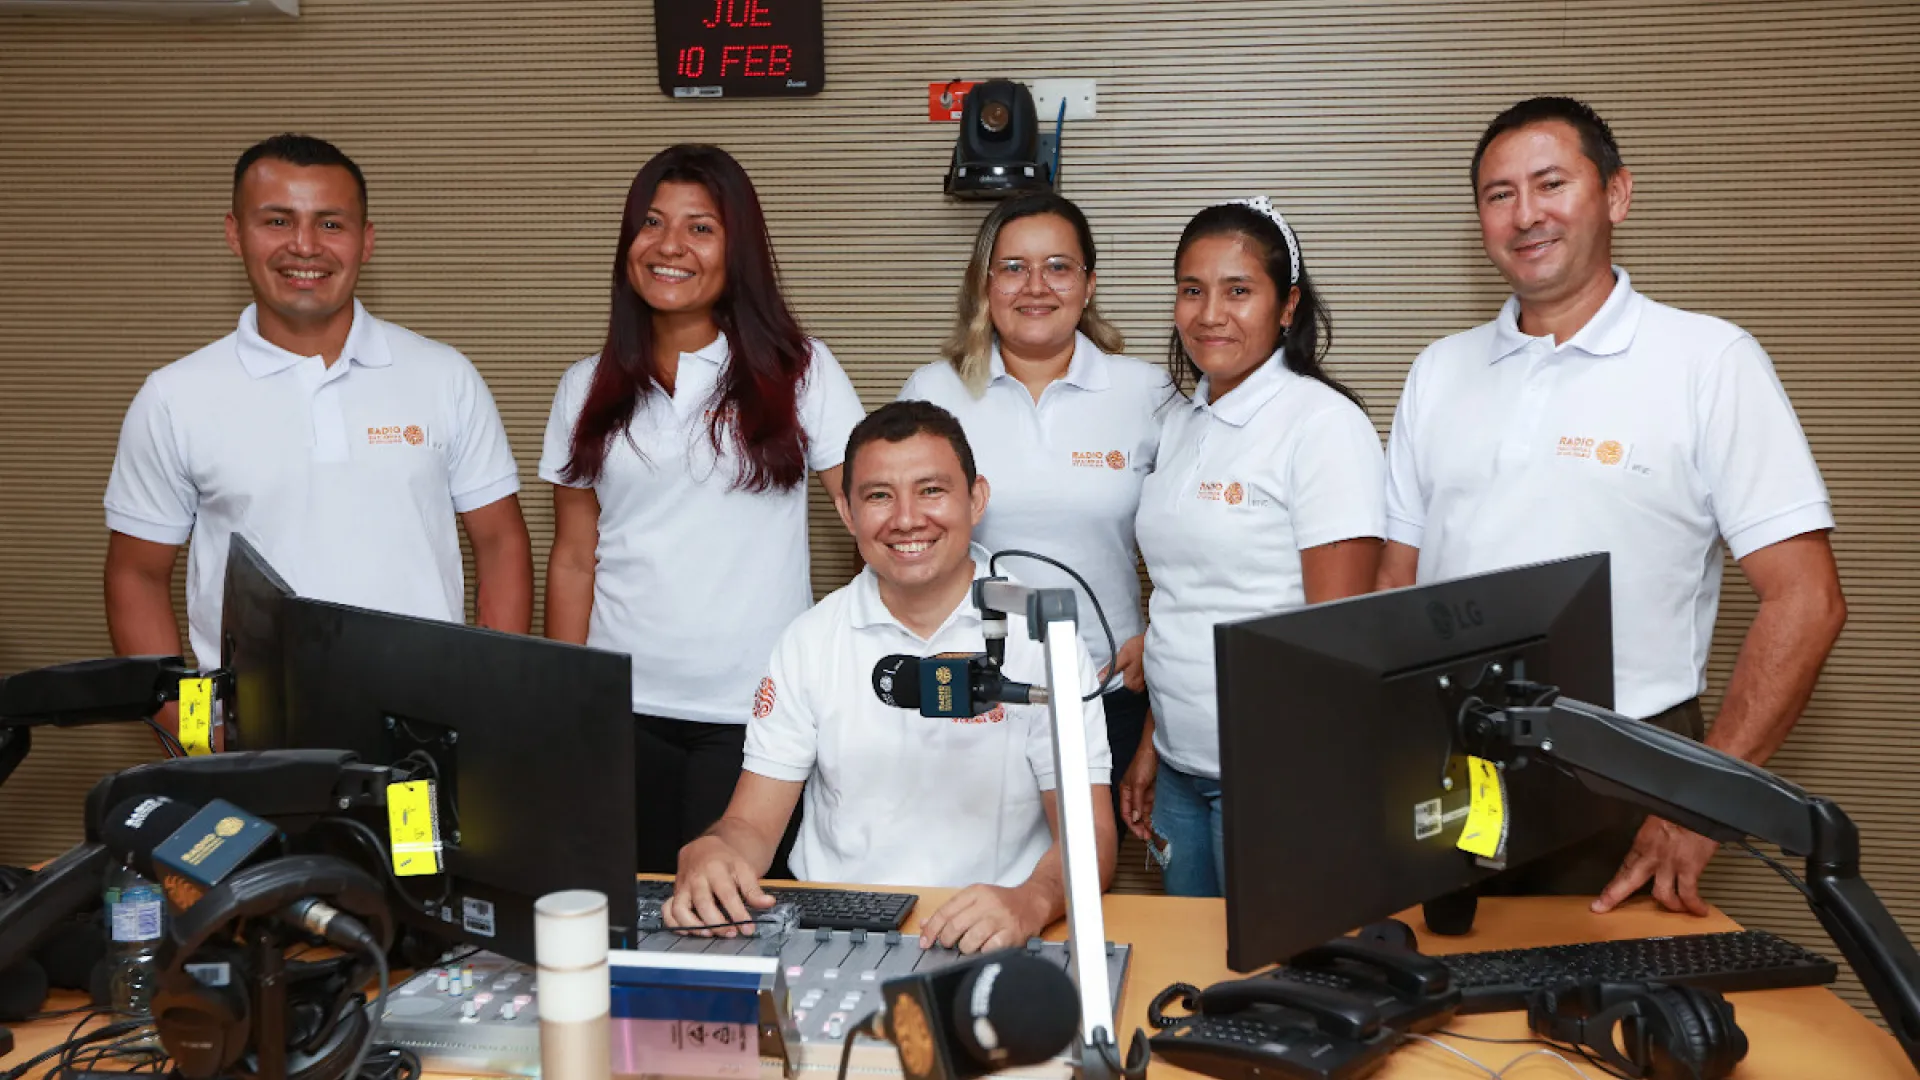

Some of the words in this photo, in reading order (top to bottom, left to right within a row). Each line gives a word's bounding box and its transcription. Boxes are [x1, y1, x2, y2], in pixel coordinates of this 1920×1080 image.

[702, 0, 772, 28] JUE
[677, 46, 705, 78] 10
[720, 45, 792, 77] FEB
[367, 426, 401, 435] RADIO
[1559, 436, 1595, 447] RADIO
[1072, 451, 1103, 459] RADIO
[1453, 599, 1484, 630] LG
